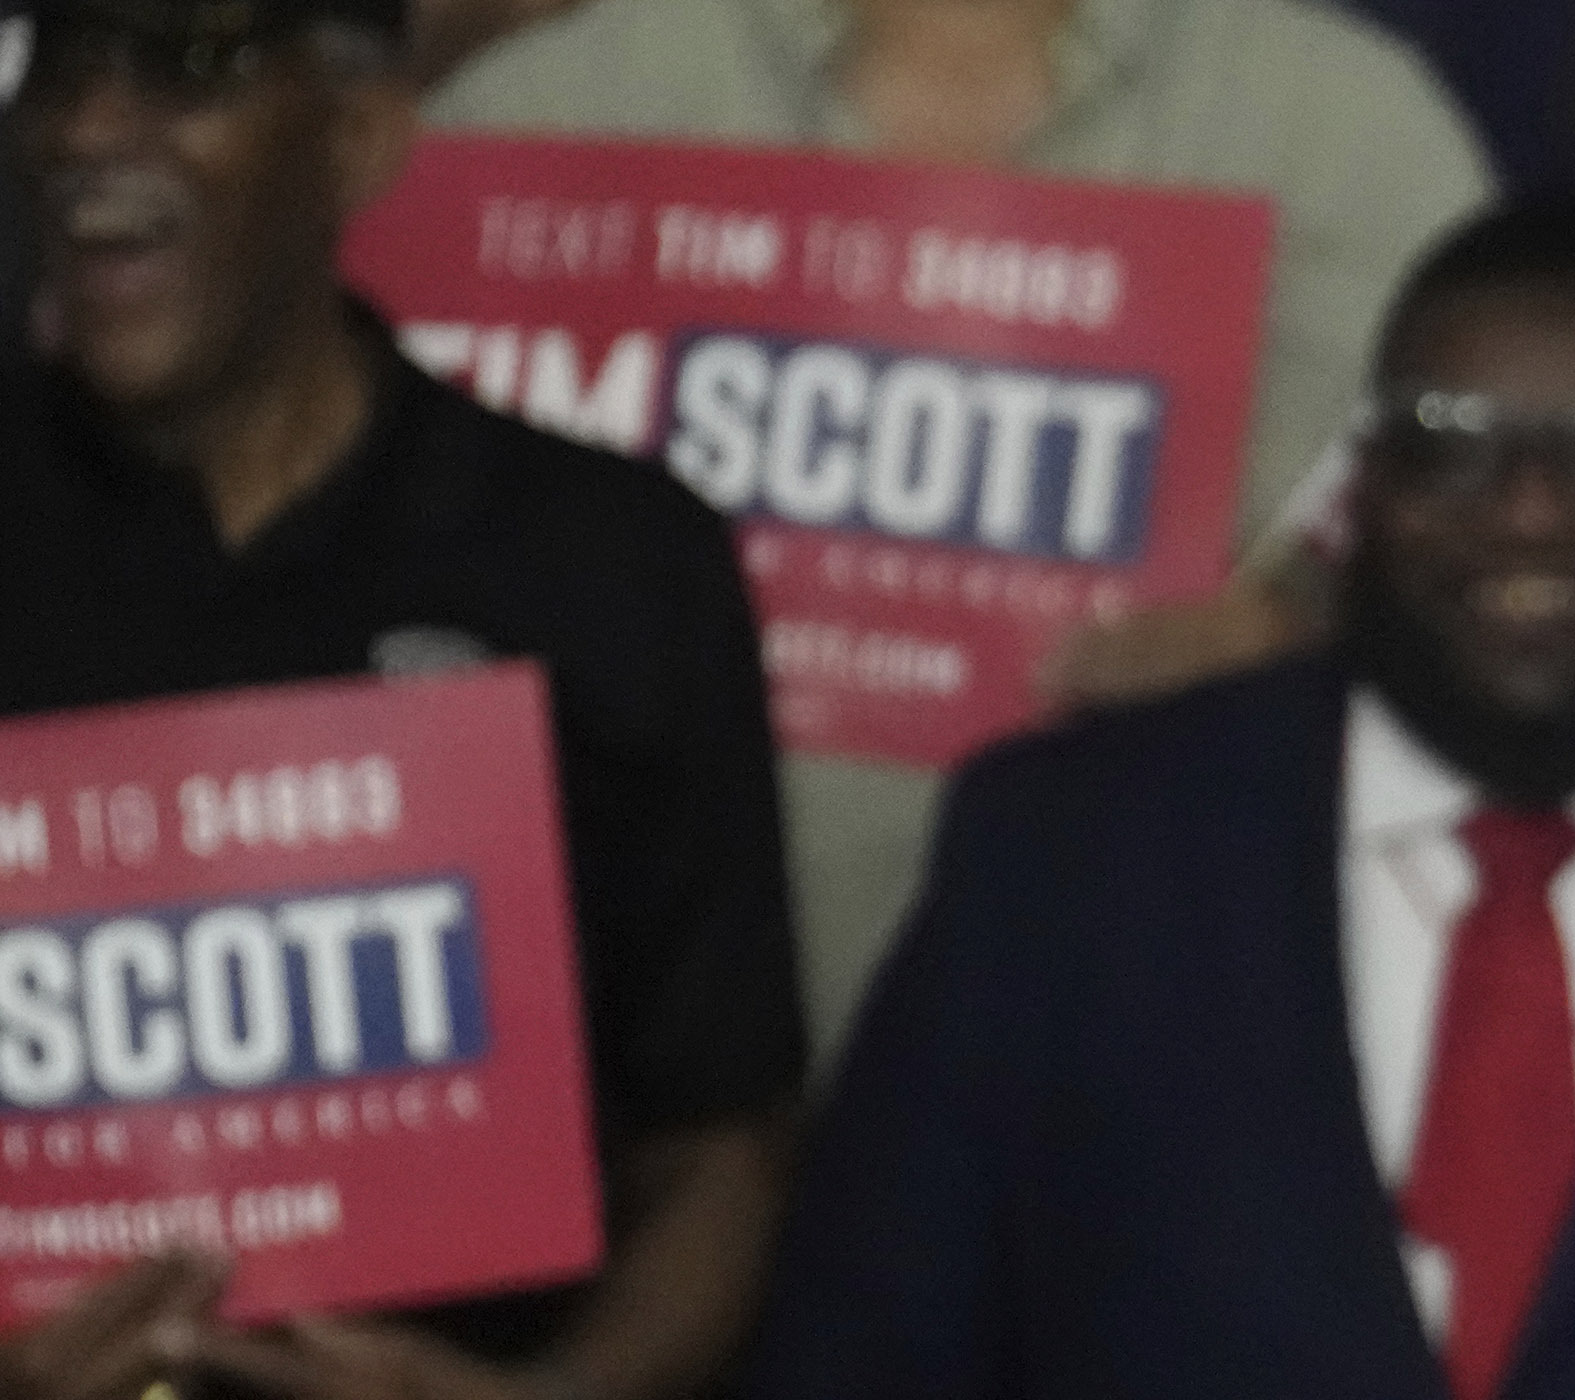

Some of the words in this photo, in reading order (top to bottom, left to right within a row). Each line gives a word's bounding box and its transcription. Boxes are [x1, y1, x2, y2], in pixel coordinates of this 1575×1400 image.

[655, 207, 784, 290] TIM
[805, 218, 893, 304] TO
[666, 332, 1155, 558] SCOTT
[74, 784, 160, 870] TO
[0, 882, 464, 1110] SCOTT
